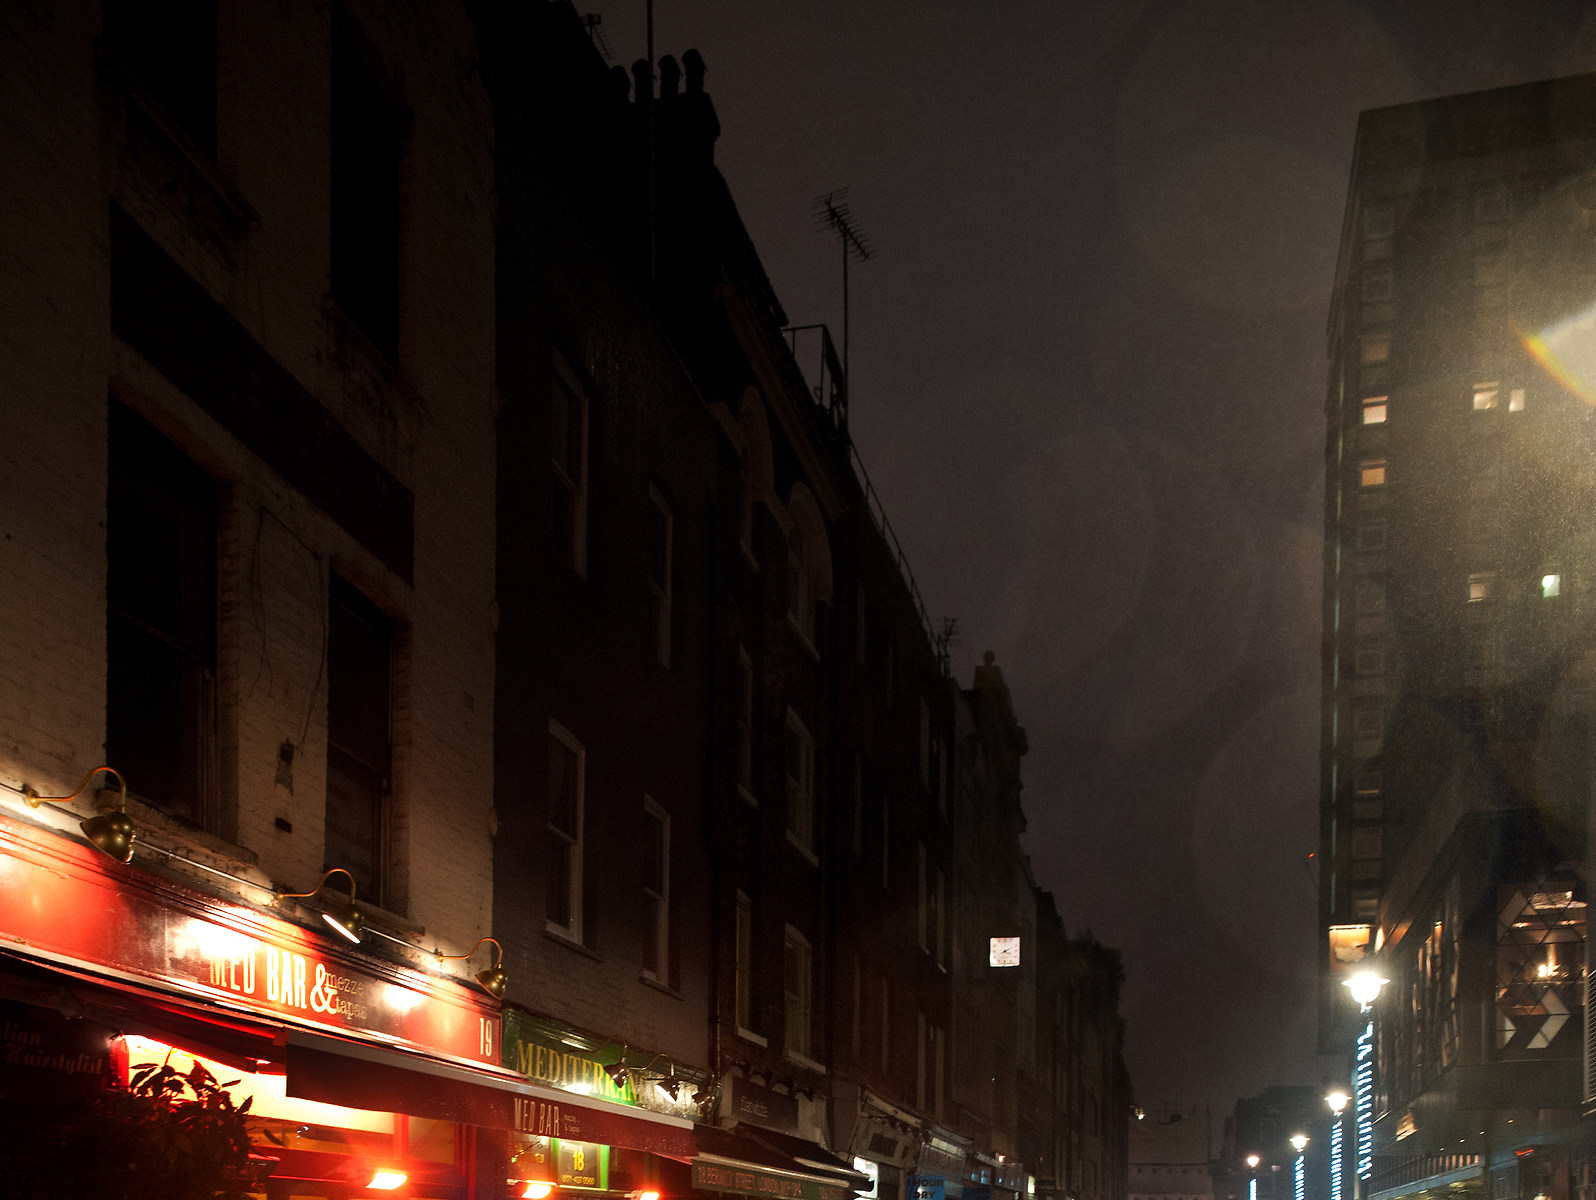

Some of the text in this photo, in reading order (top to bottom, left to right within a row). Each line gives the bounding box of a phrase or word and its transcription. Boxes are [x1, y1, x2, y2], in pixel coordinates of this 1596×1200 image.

[265, 946, 308, 1009] BAR
[310, 963, 338, 1015] &
[335, 996, 368, 1020] tapas
[479, 1017, 493, 1057] 19
[514, 1097, 560, 1137] MED BAR
[572, 1149, 585, 1172] 18
[735, 1171, 755, 1191] STREET
[914, 1178, 945, 1188] HOUR
[914, 1191, 935, 1199] DRY
